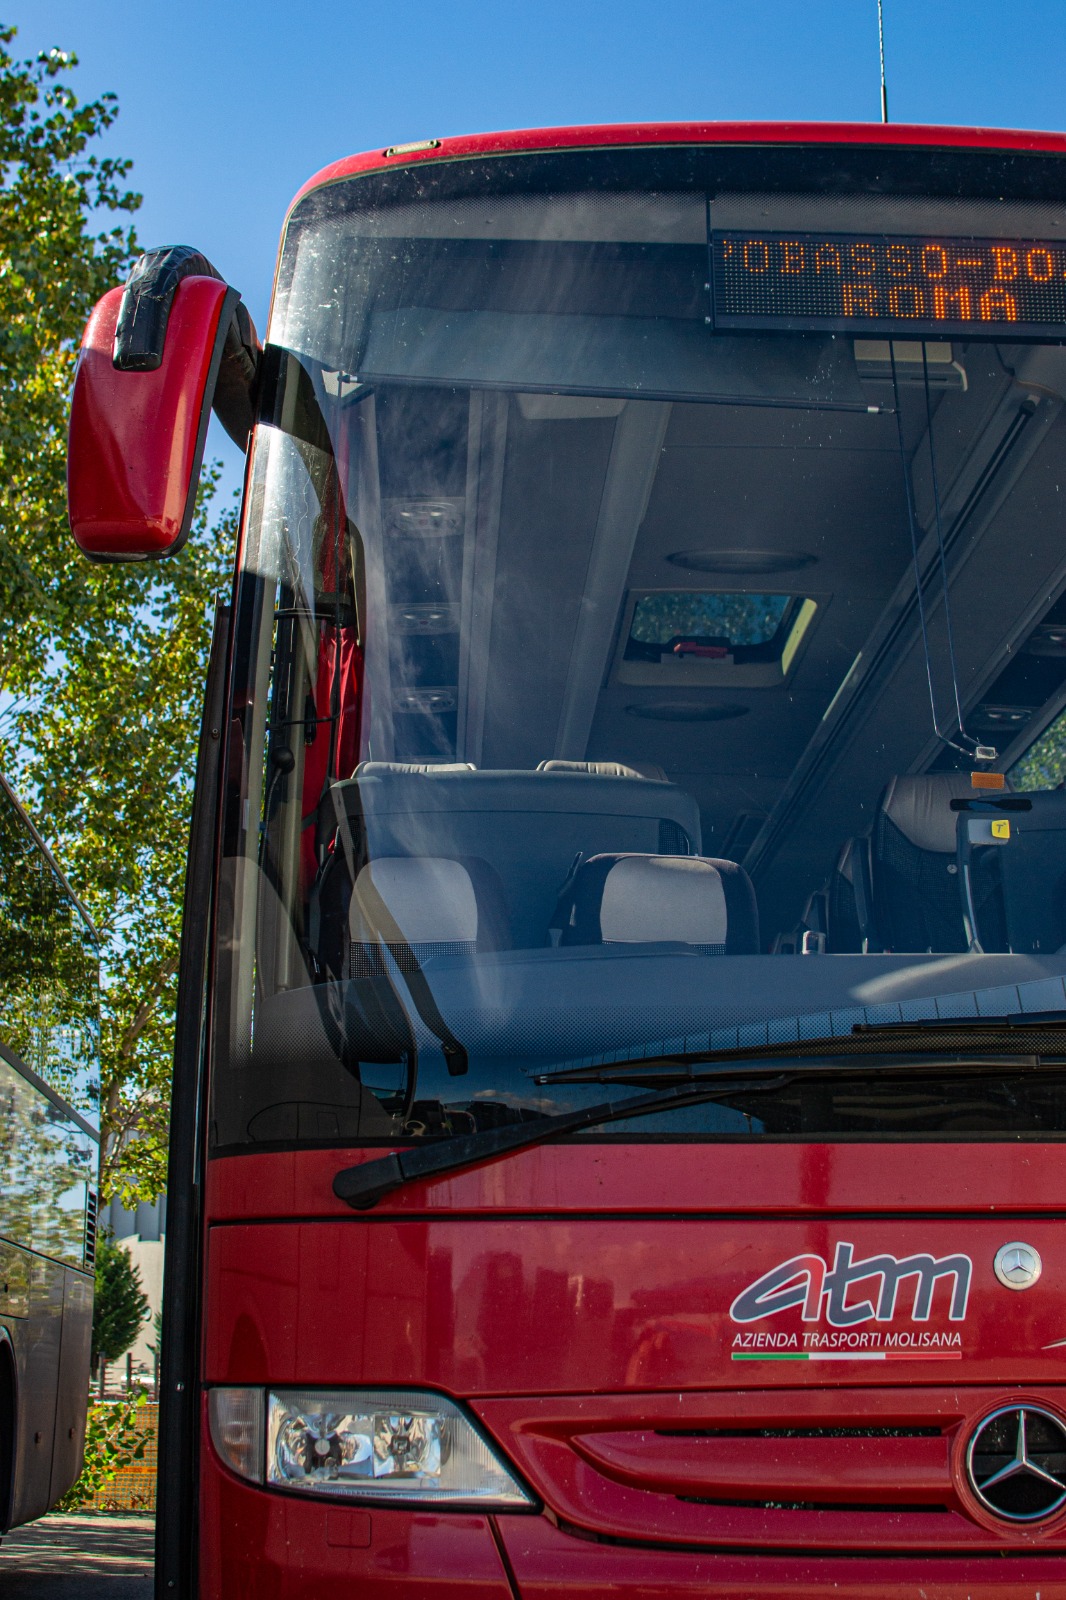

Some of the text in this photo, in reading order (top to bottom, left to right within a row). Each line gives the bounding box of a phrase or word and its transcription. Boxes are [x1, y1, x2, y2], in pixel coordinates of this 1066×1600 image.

[723, 240, 1066, 281] OBASSO-BO
[843, 284, 1016, 321] ROMA
[732, 1332, 961, 1348] AZIENDA TRASPORTI MOLISANA
